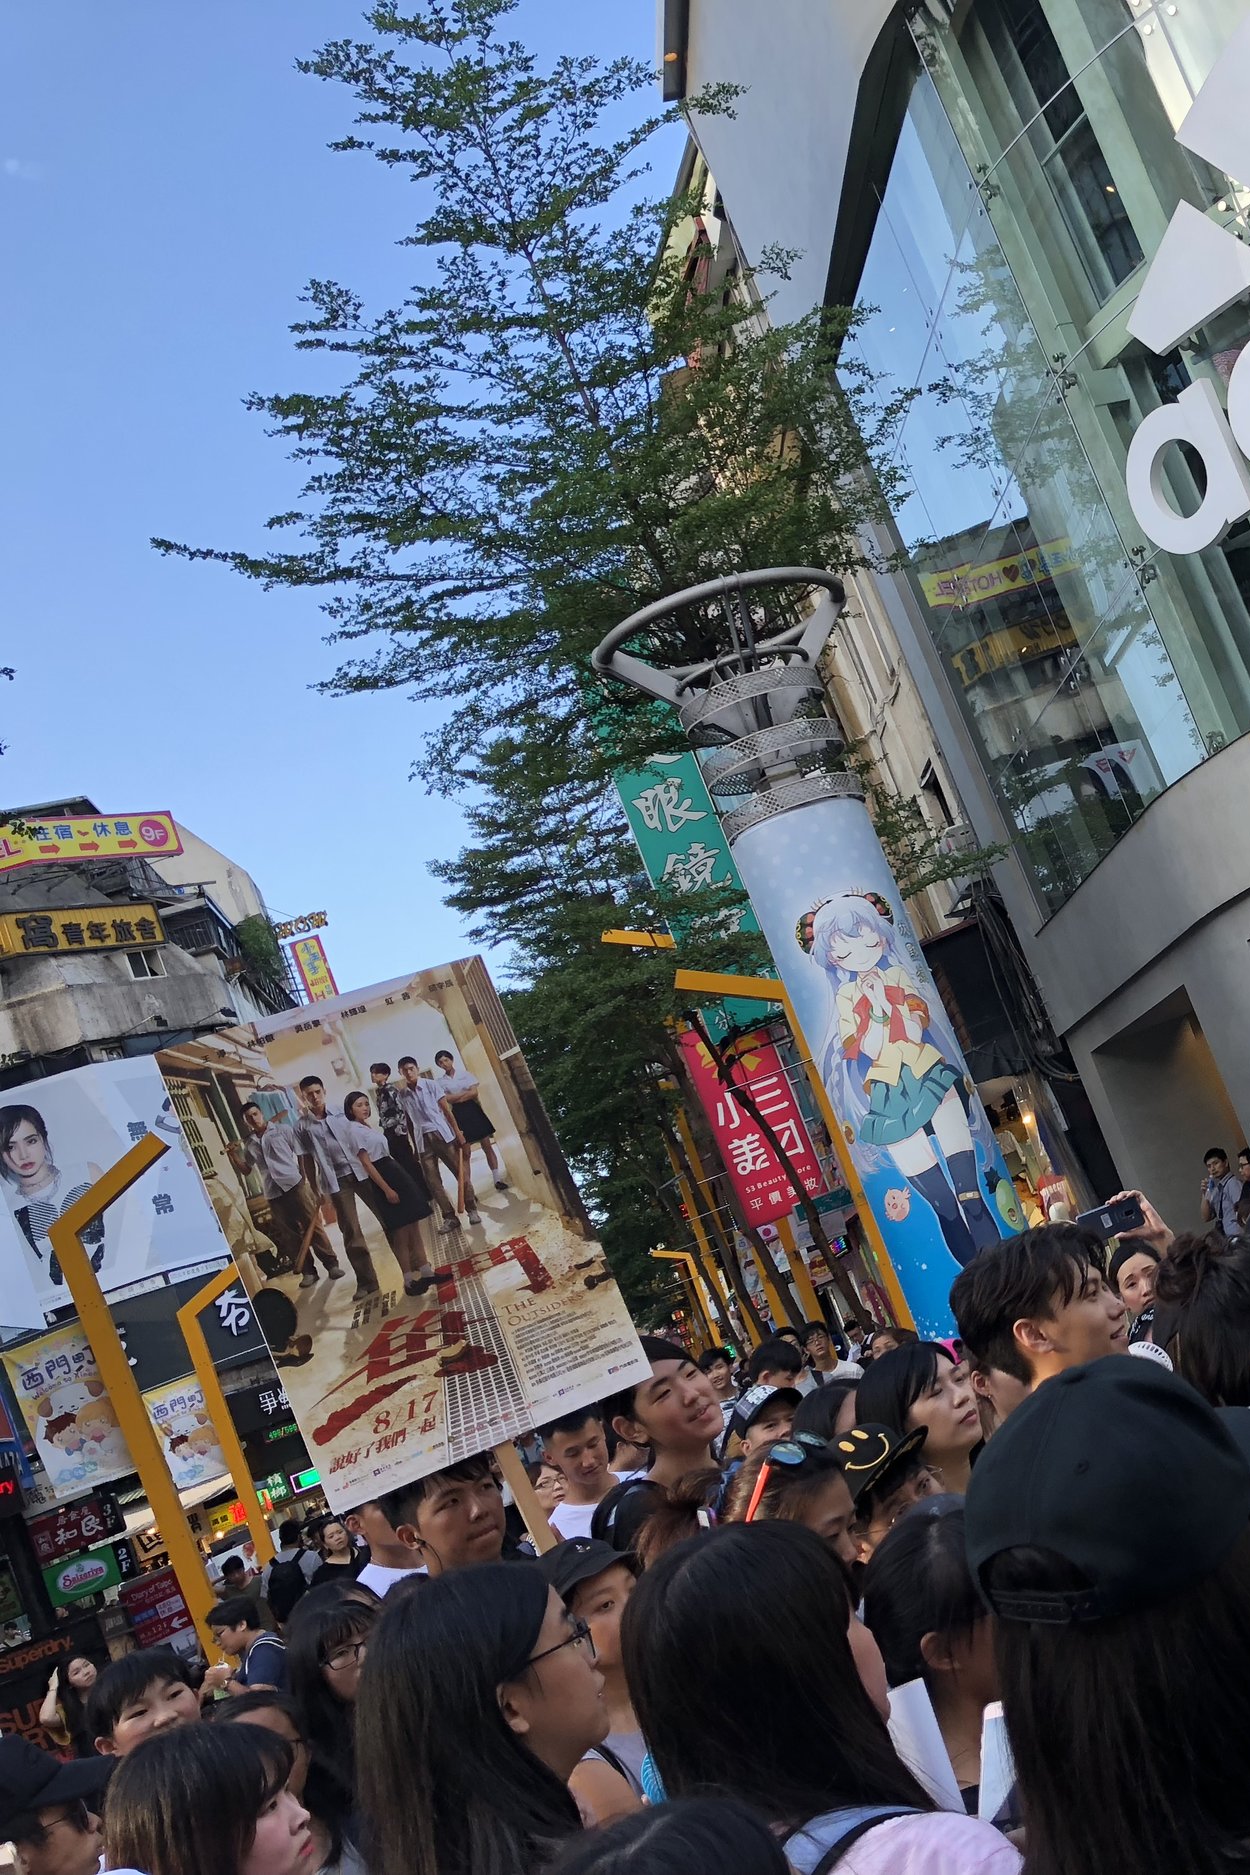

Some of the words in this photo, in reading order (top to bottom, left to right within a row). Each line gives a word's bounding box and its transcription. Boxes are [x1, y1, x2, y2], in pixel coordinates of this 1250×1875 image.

[93, 821, 133, 837] 休息
[141, 826, 166, 841] 9F
[745, 1184, 757, 1194] S3
[757, 1174, 787, 1191] Beauty
[503, 1298, 537, 1316] THE
[507, 1295, 584, 1327] OUTSIDERS
[372, 1389, 438, 1435] 8/17
[328, 1416, 437, 1475] 說好了我們一起
[54, 1514, 104, 1546] 和民
[117, 1546, 132, 1573] 2F
[62, 1566, 105, 1588] Saizeriya
